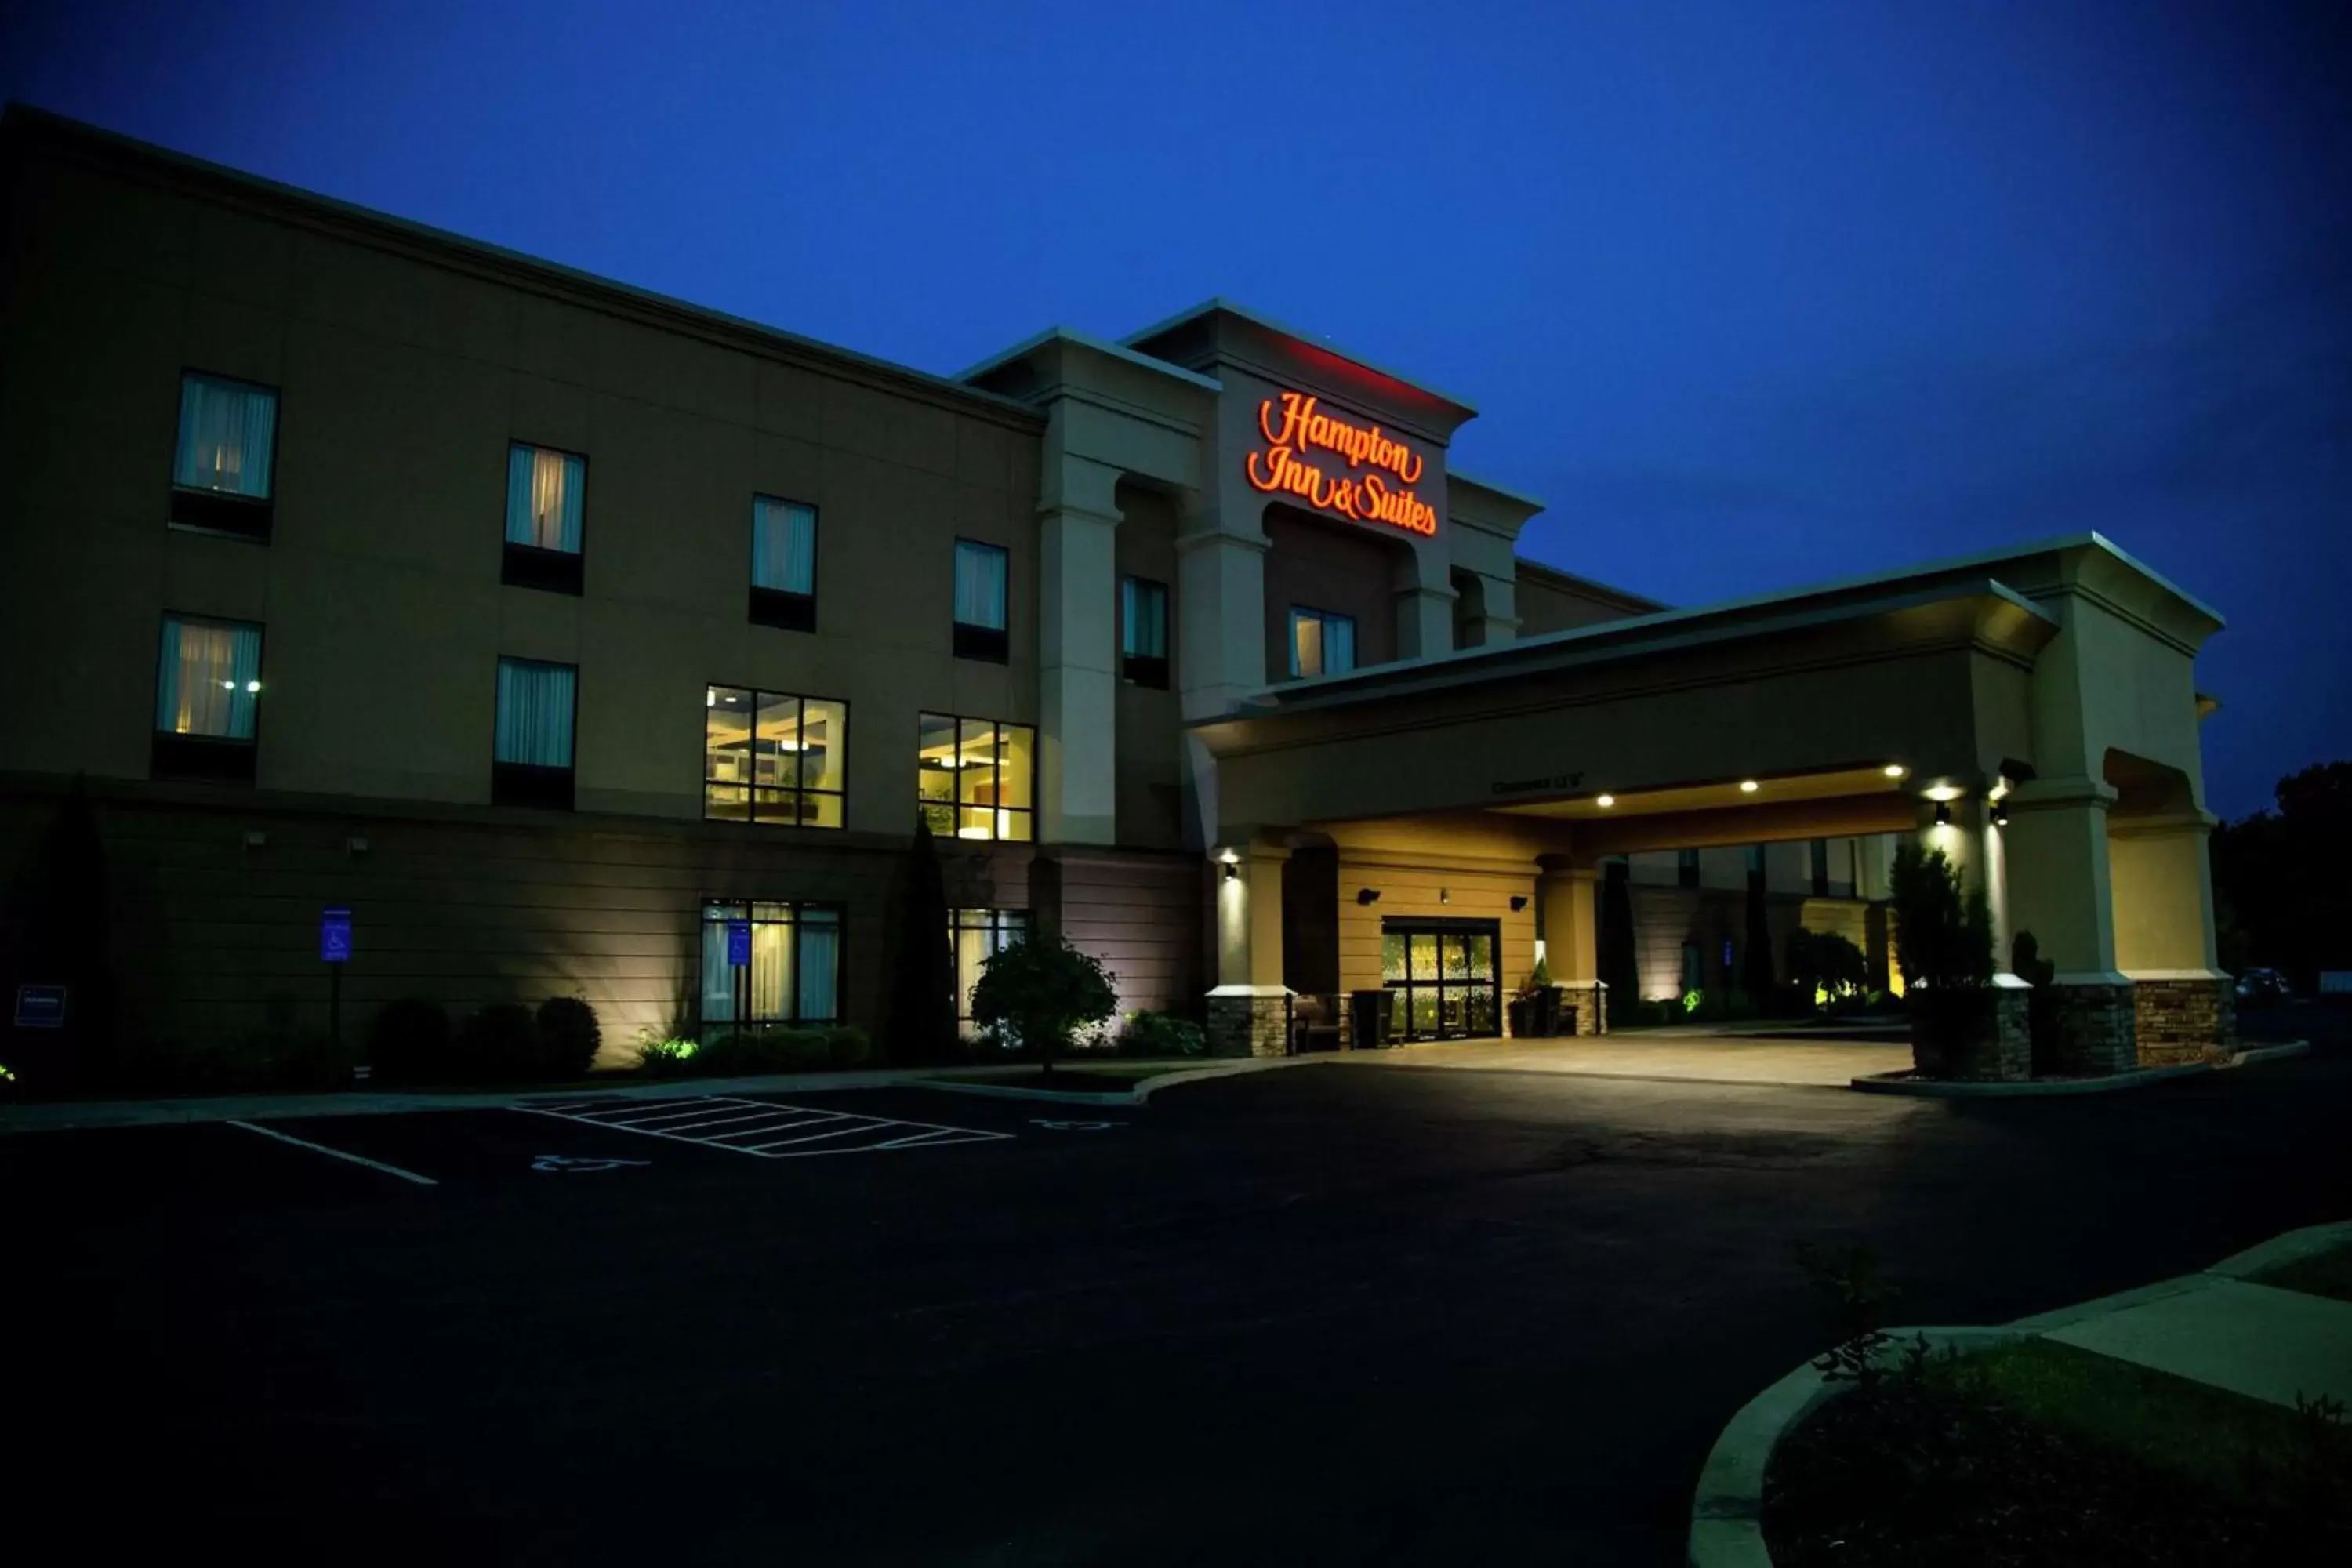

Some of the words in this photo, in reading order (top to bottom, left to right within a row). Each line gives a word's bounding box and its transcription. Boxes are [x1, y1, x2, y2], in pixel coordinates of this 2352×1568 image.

[1258, 390, 1423, 485] Hampton
[1246, 445, 1336, 509] Inn
[1334, 477, 1360, 521] &
[1354, 474, 1437, 536] Suites
